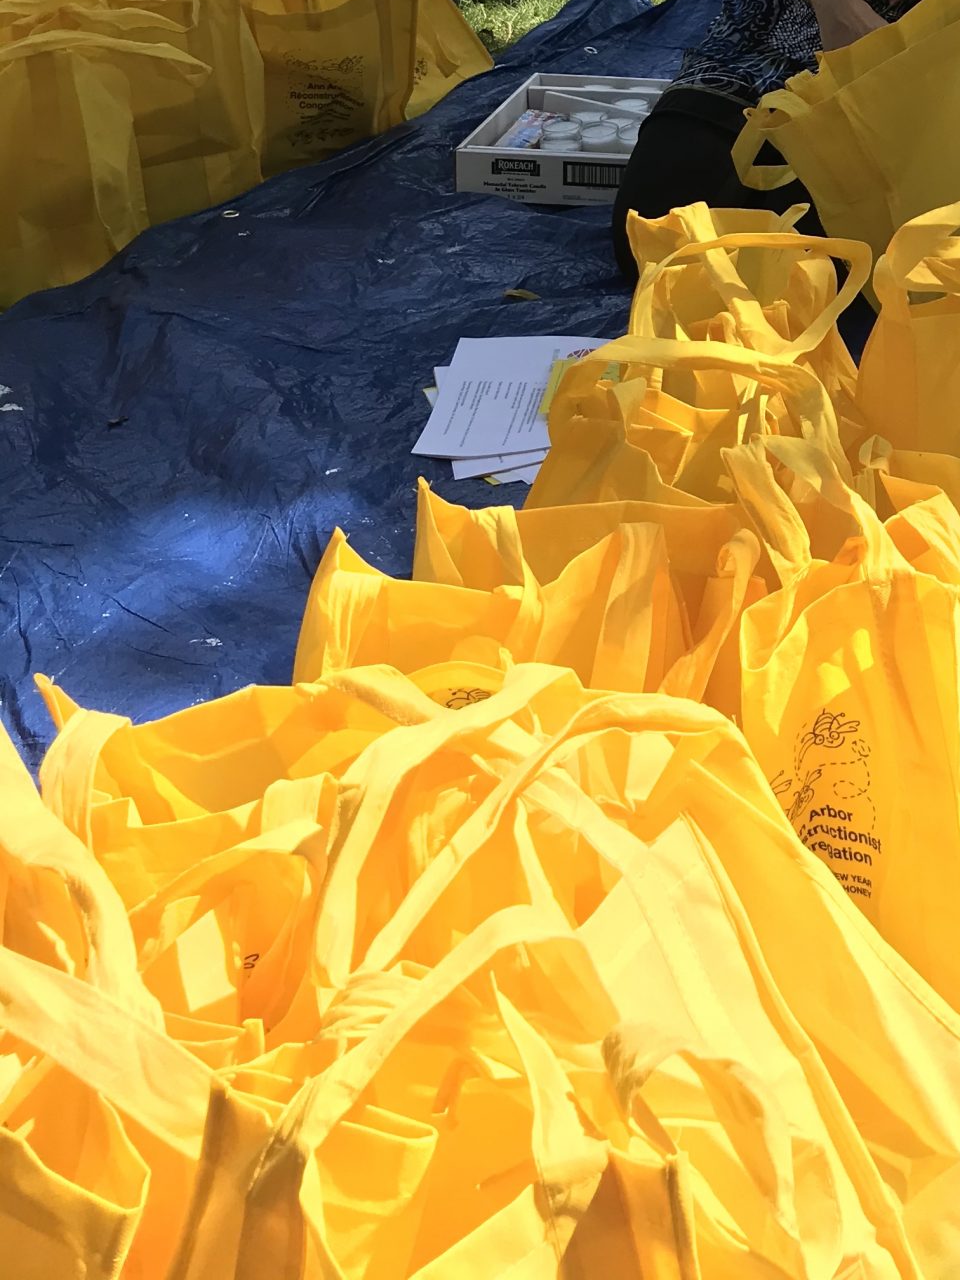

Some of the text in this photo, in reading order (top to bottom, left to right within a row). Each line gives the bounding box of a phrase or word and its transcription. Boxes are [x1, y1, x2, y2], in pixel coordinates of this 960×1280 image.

[498, 160, 534, 170] ROKEACH
[809, 804, 853, 822] Arbor
[808, 841, 872, 866] regation
[850, 873, 872, 888] YEAR
[843, 885, 872, 899] HONEY
